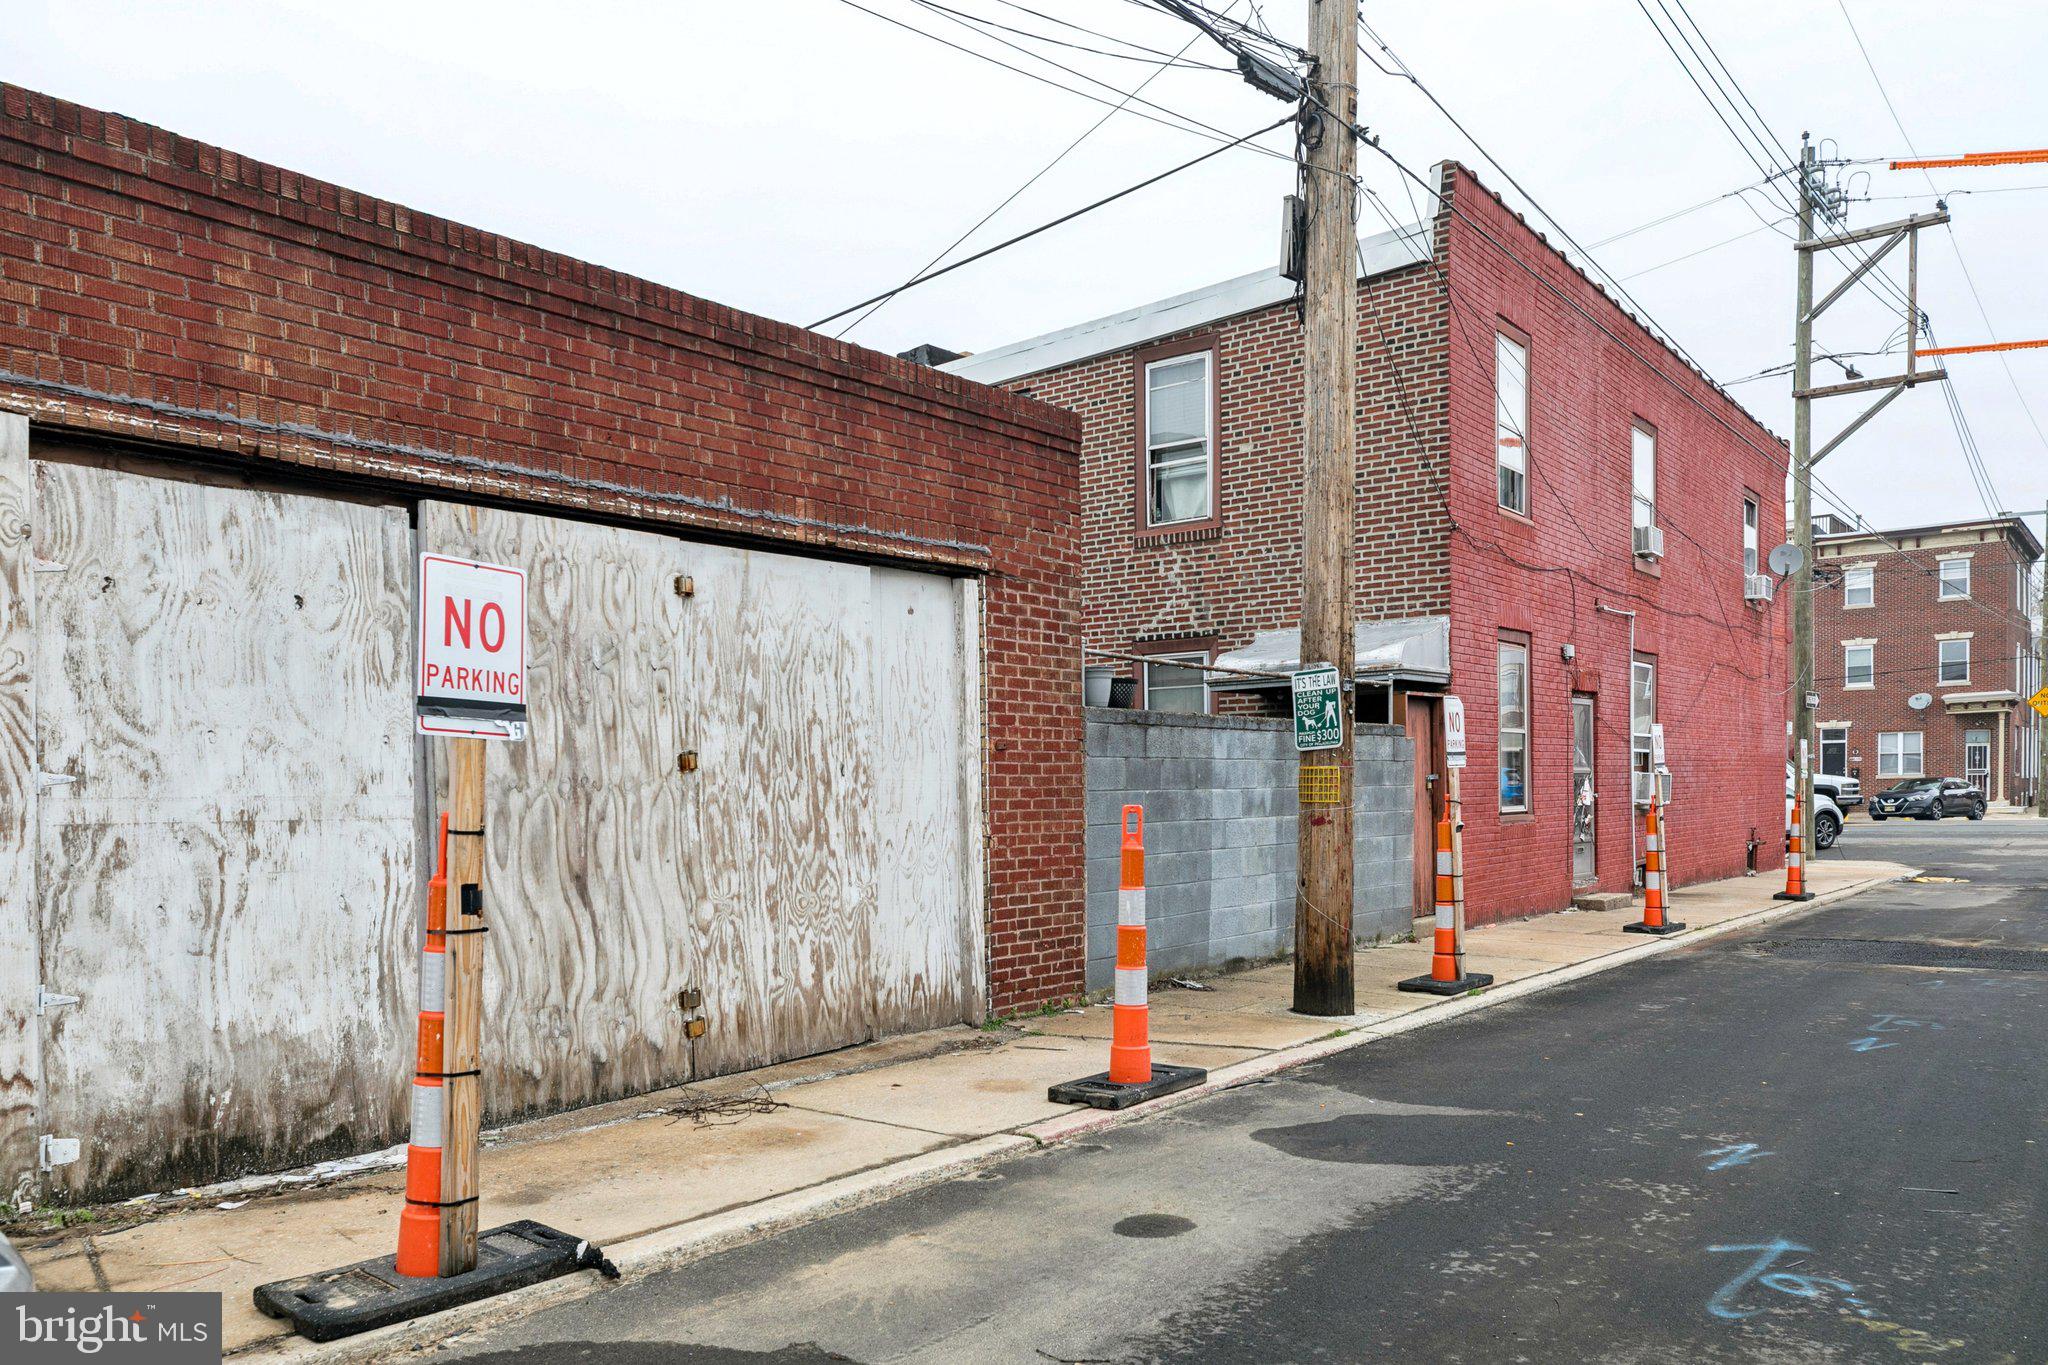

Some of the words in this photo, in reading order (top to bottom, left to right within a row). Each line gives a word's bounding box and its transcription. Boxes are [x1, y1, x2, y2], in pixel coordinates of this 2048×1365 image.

[444, 596, 505, 653] NO
[426, 663, 520, 696] PARKING
[1294, 677, 1306, 690] IT'S
[1308, 675, 1321, 688] THE
[1322, 674, 1336, 686] LAW
[1297, 690, 1322, 698] CLEAN
[1298, 696, 1322, 704] AFTER
[1448, 712, 1460, 732] NO
[1316, 728, 1340, 742] $300
